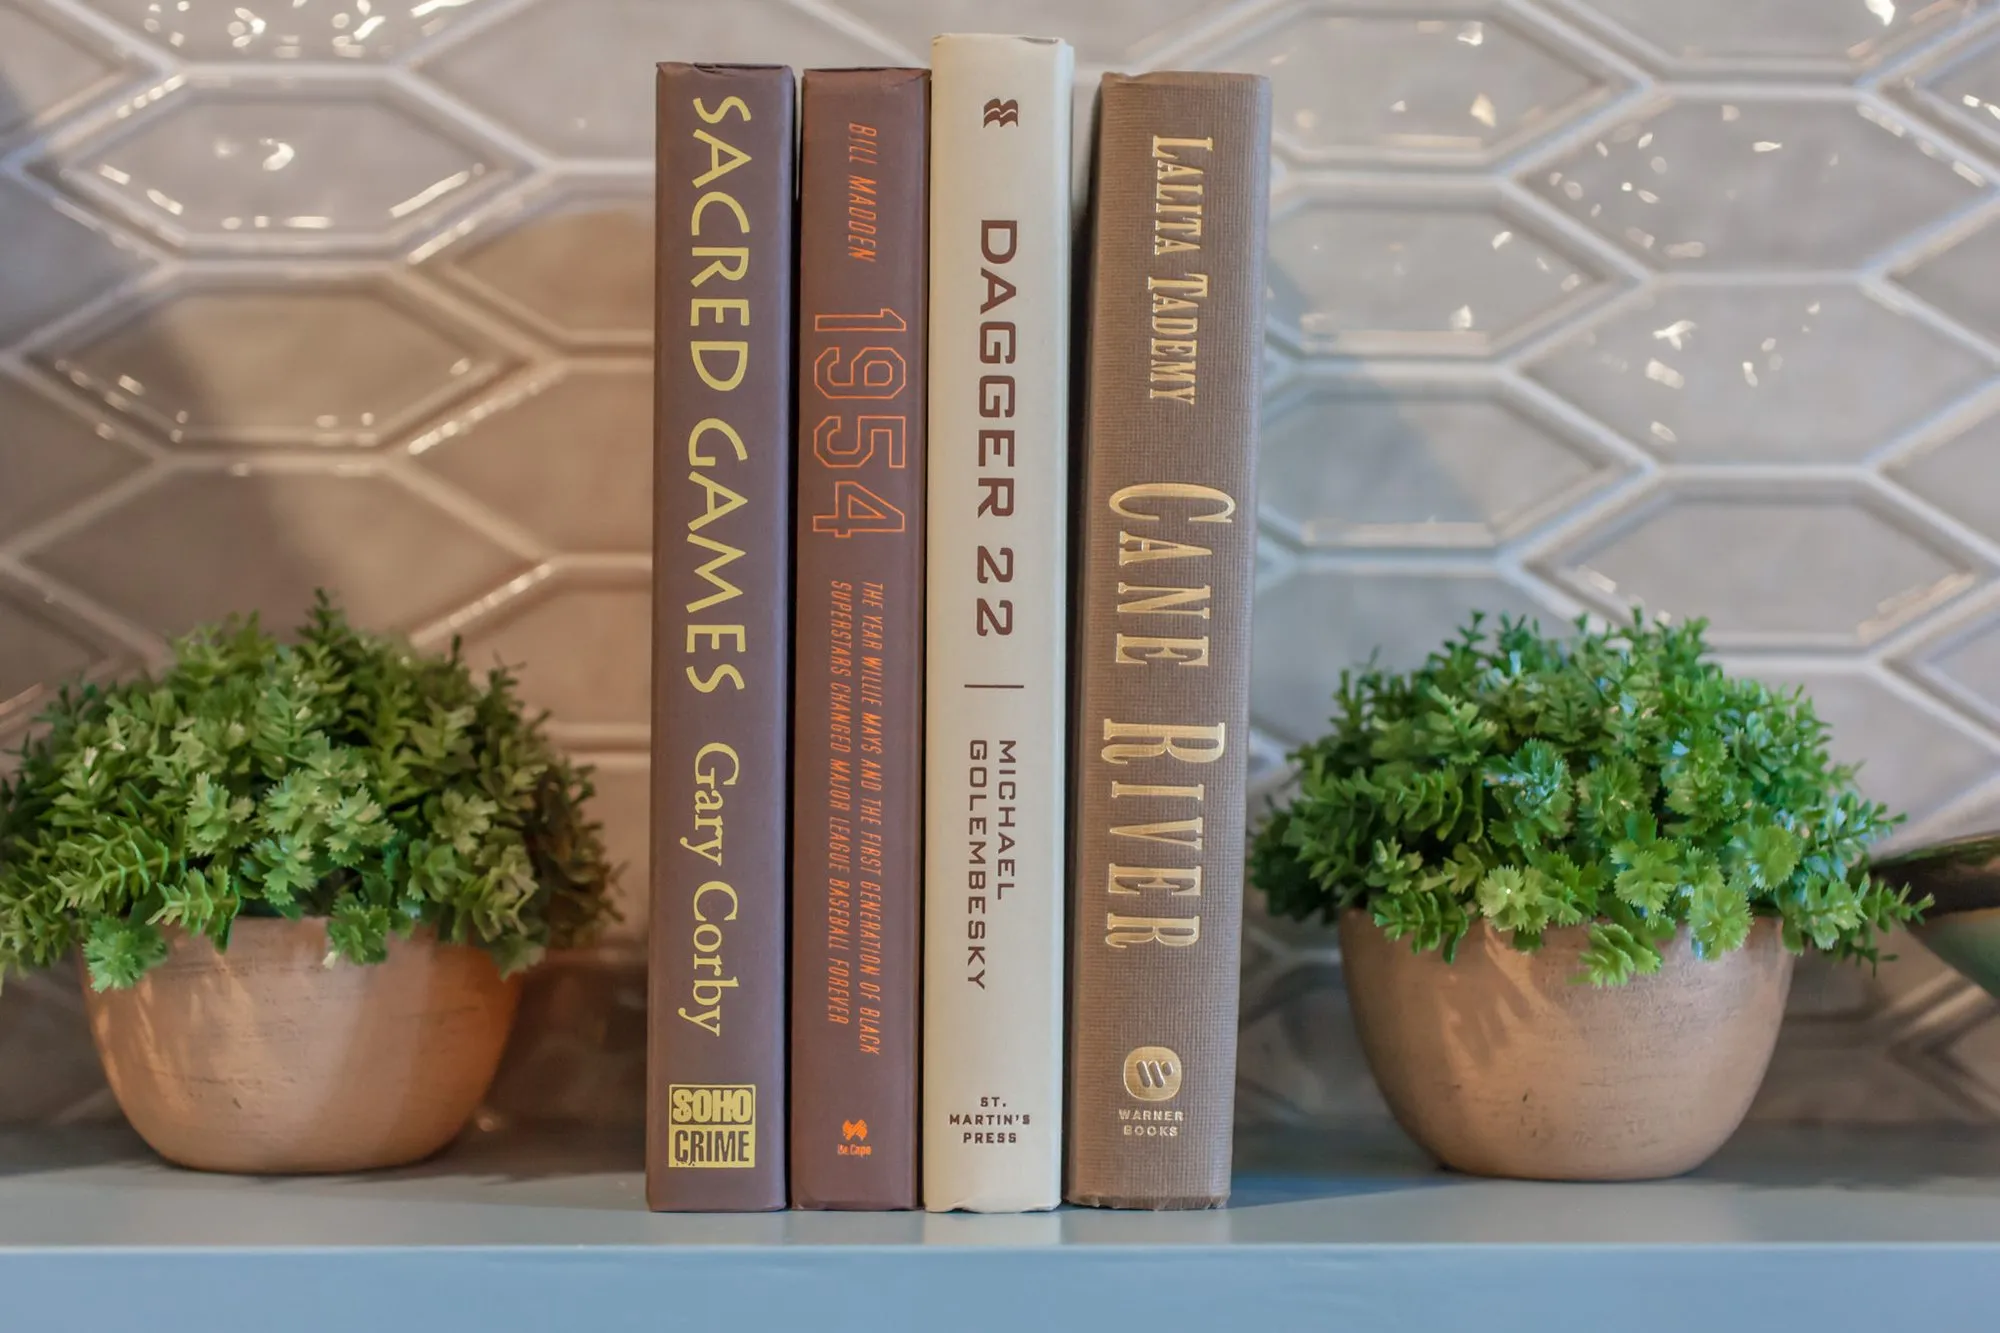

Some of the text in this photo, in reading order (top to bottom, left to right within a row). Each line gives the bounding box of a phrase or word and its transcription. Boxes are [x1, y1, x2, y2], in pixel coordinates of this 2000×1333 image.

[848, 122, 877, 262] BILL MADDEN
[1148, 135, 1214, 405] LALITA TADEMY
[686, 96, 752, 694] SACRED GAMES
[812, 308, 907, 538] 1954
[976, 219, 1018, 638] DAGGER 22
[828, 580, 852, 1025] SUPERSTARS CHANGED MAJOR LEAGUE BASEBALL FOREVER
[1101, 483, 1236, 949] CANE RIVER
[678, 742, 740, 1037] Gary Corby
[859, 581, 884, 1055] THE YEAR WILLIE MAYS AND THE FIRST GENERATION OF BLACK
[967, 740, 988, 990] GOLEMBESKY
[997, 740, 1016, 901] MICHAEL
[672, 1088, 753, 1123] SOHO
[674, 1129, 750, 1162] CRIME
[949, 1114, 1030, 1125] MARTIN'S
[963, 1132, 1017, 1144] PRESS
[980, 1096, 1007, 1107] ST.
[1118, 1109, 1184, 1121] WARNER
[1123, 1125, 1178, 1137] BOOKS
